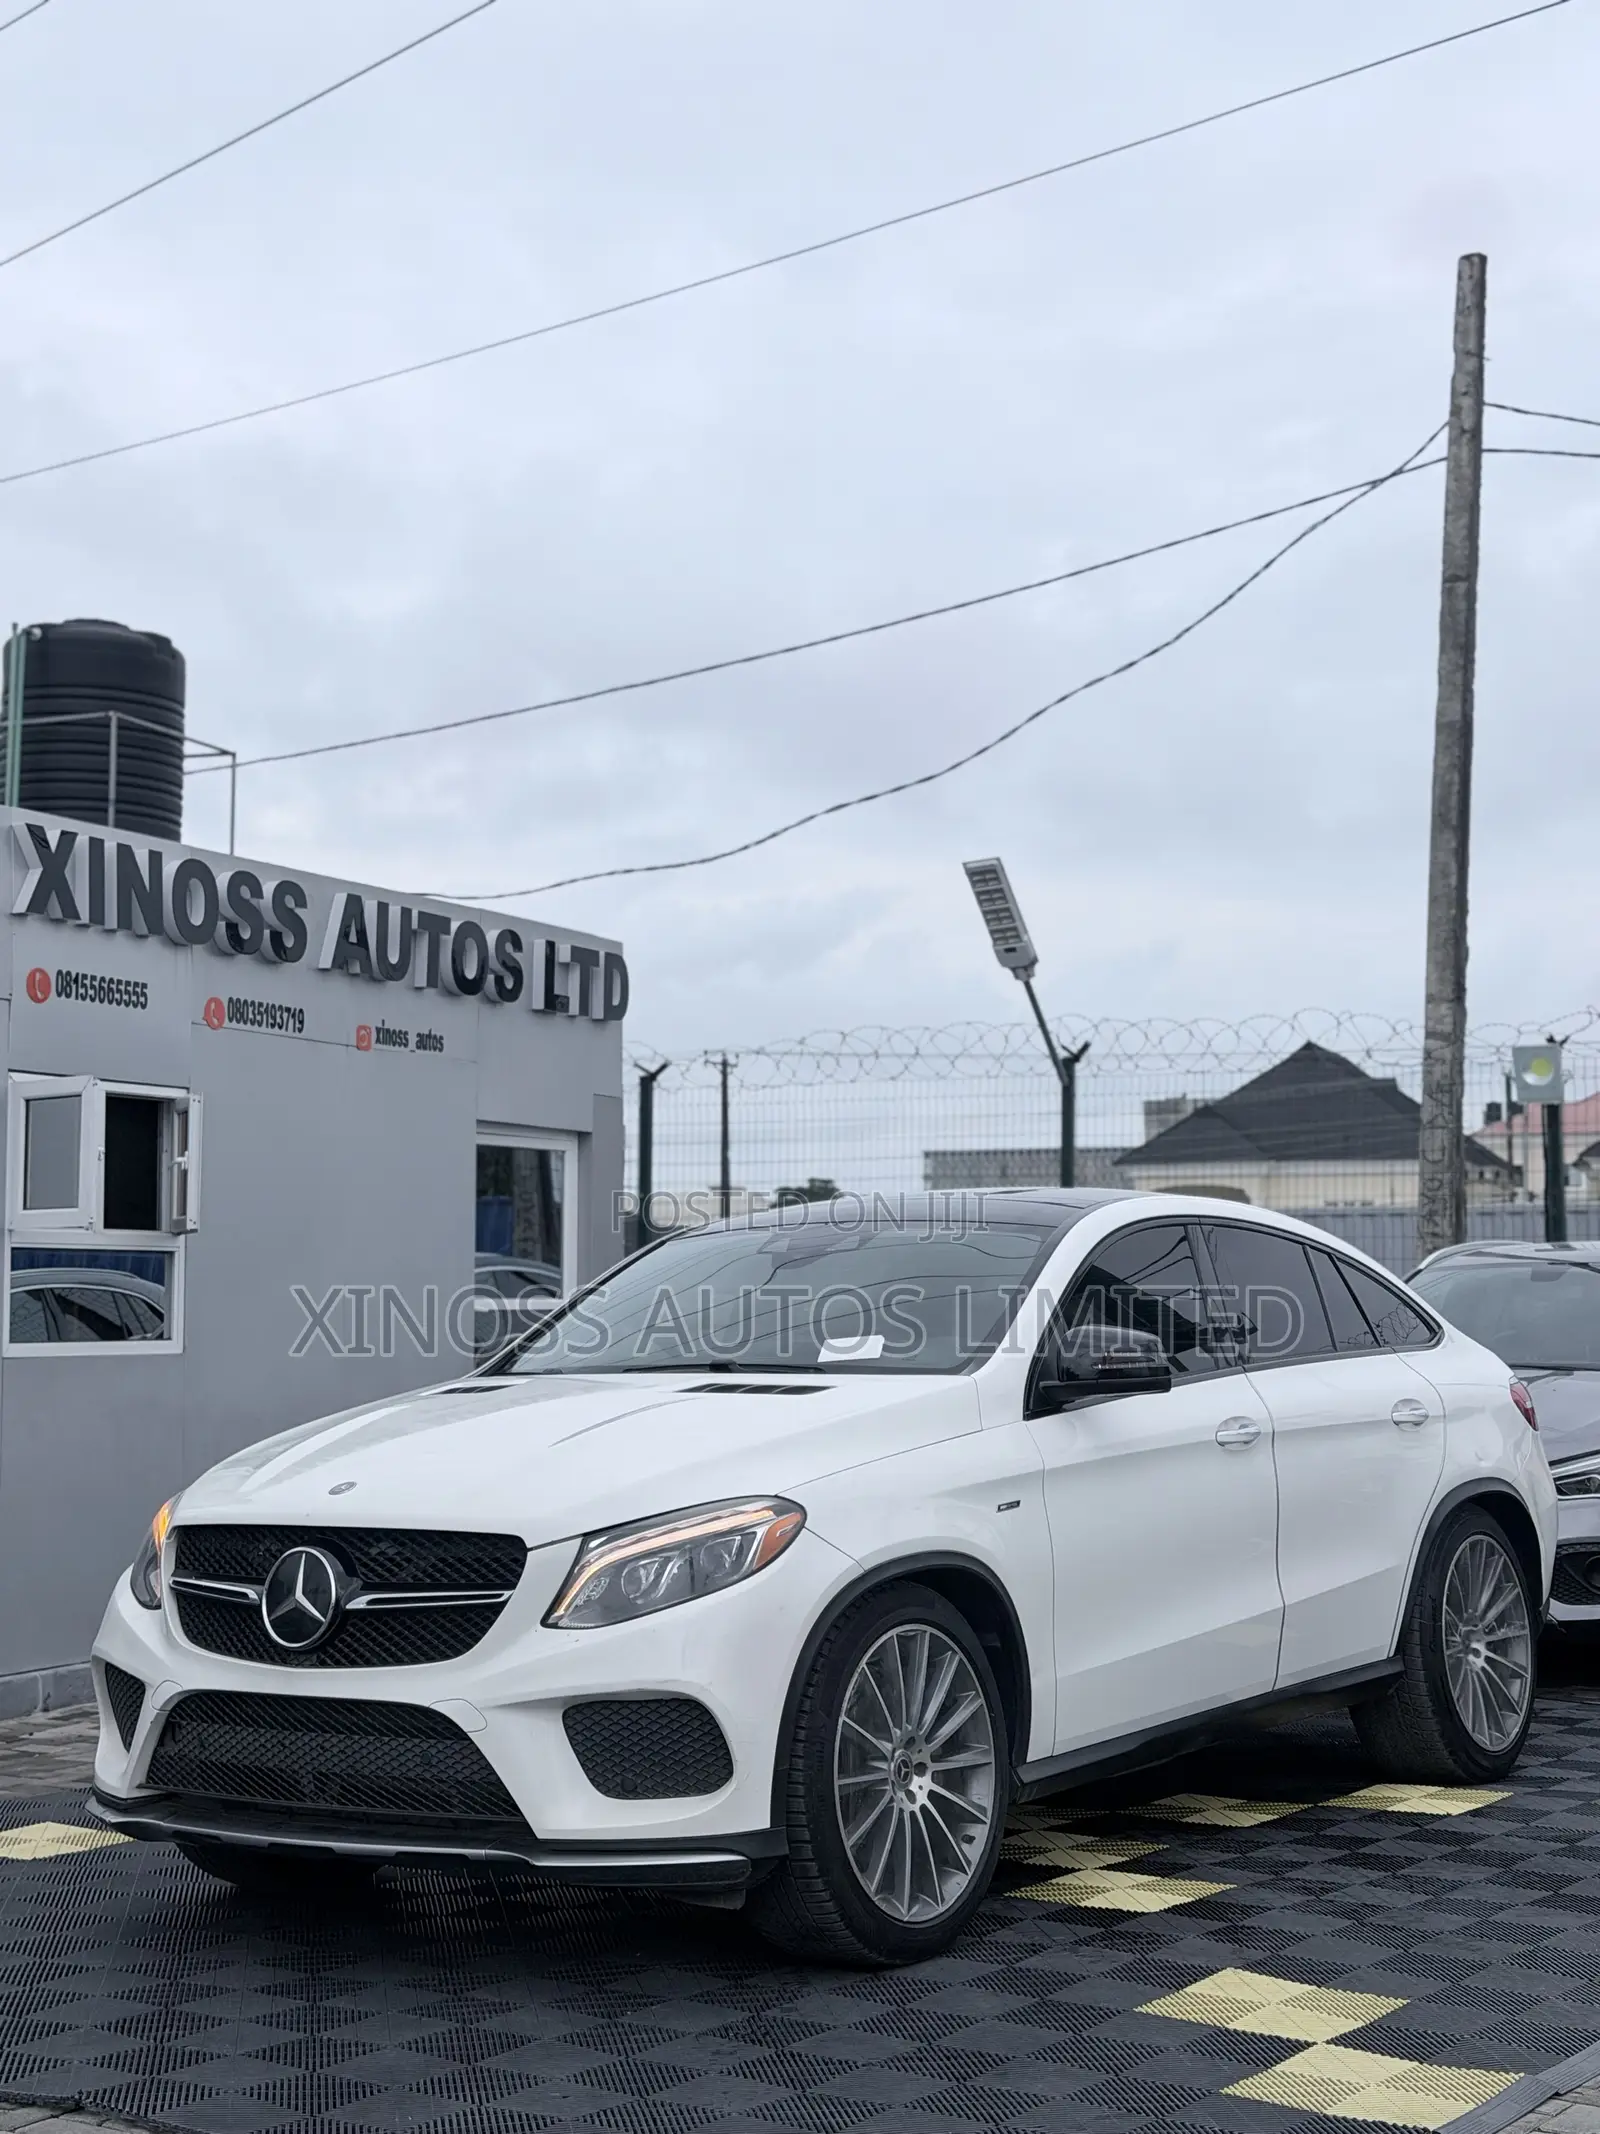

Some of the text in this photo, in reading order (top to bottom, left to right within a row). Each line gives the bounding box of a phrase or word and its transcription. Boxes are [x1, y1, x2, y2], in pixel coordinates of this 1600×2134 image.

[13, 822, 630, 1022] XINOSS AUTOS LTD
[55, 969, 149, 1010] 08155665555
[227, 996, 305, 1034] 08035193719
[375, 1018, 445, 1053] xinoss_autos
